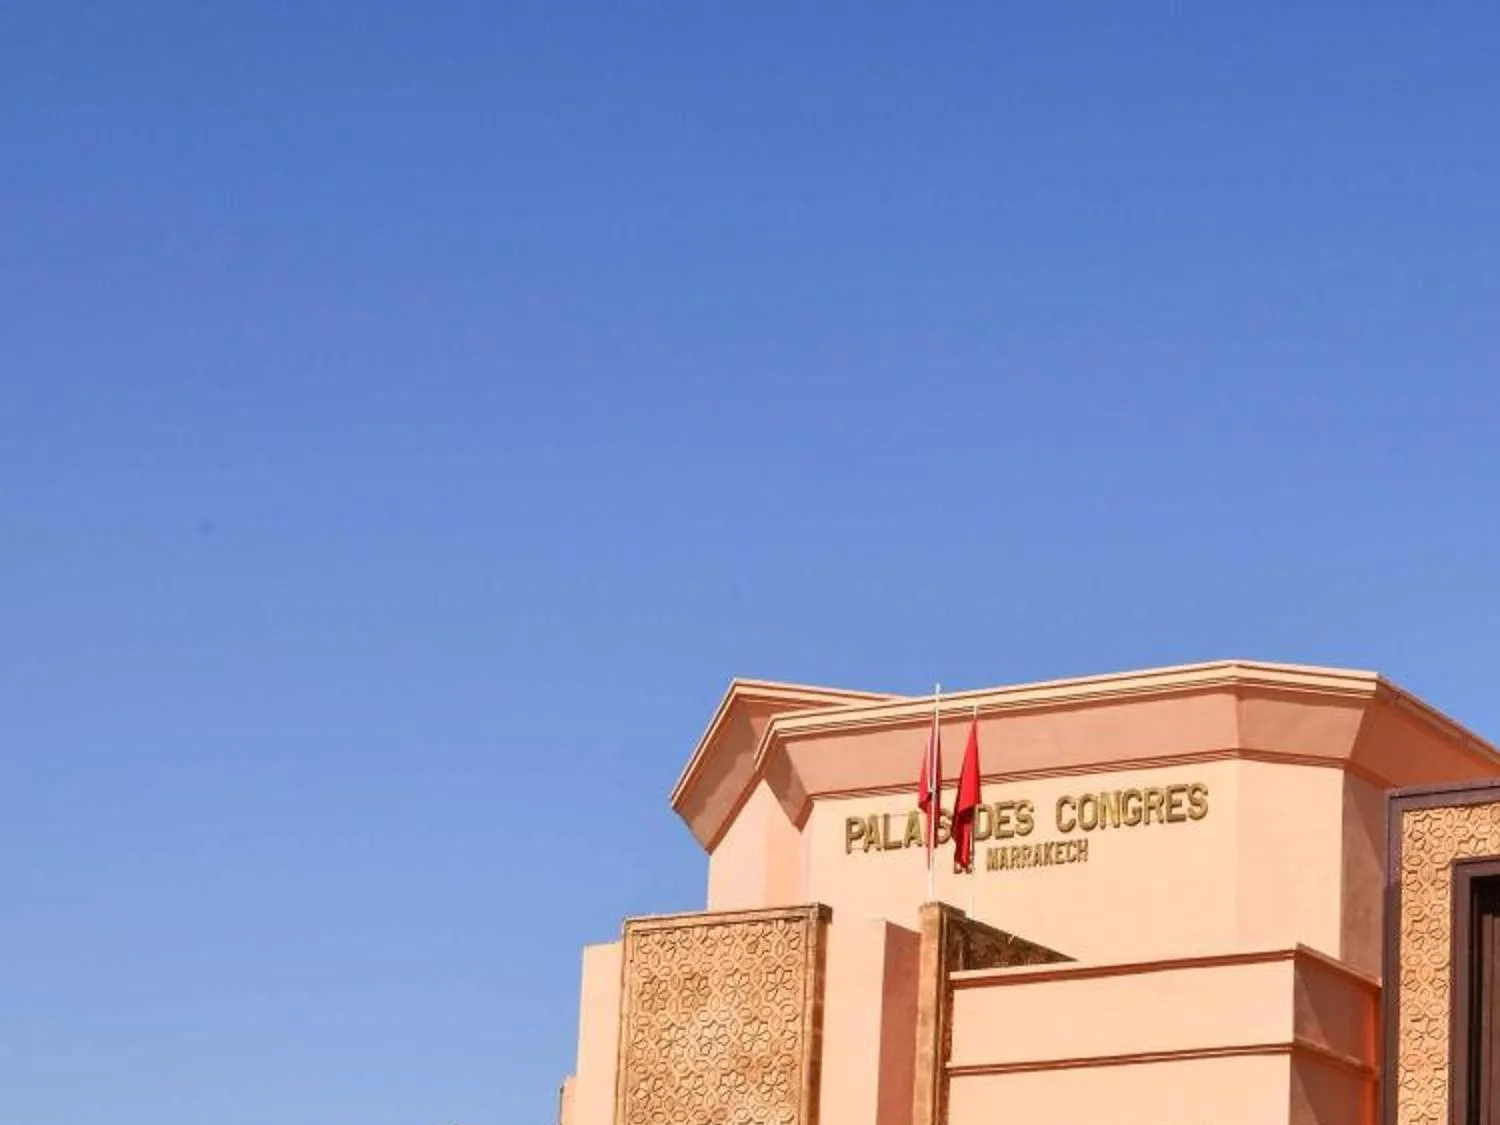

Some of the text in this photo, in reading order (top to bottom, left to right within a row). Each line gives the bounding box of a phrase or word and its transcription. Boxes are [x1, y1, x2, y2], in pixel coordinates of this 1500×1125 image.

[845, 782, 1209, 855] PALAS DES CONGRES
[986, 838, 1089, 873] MARRAKECH
